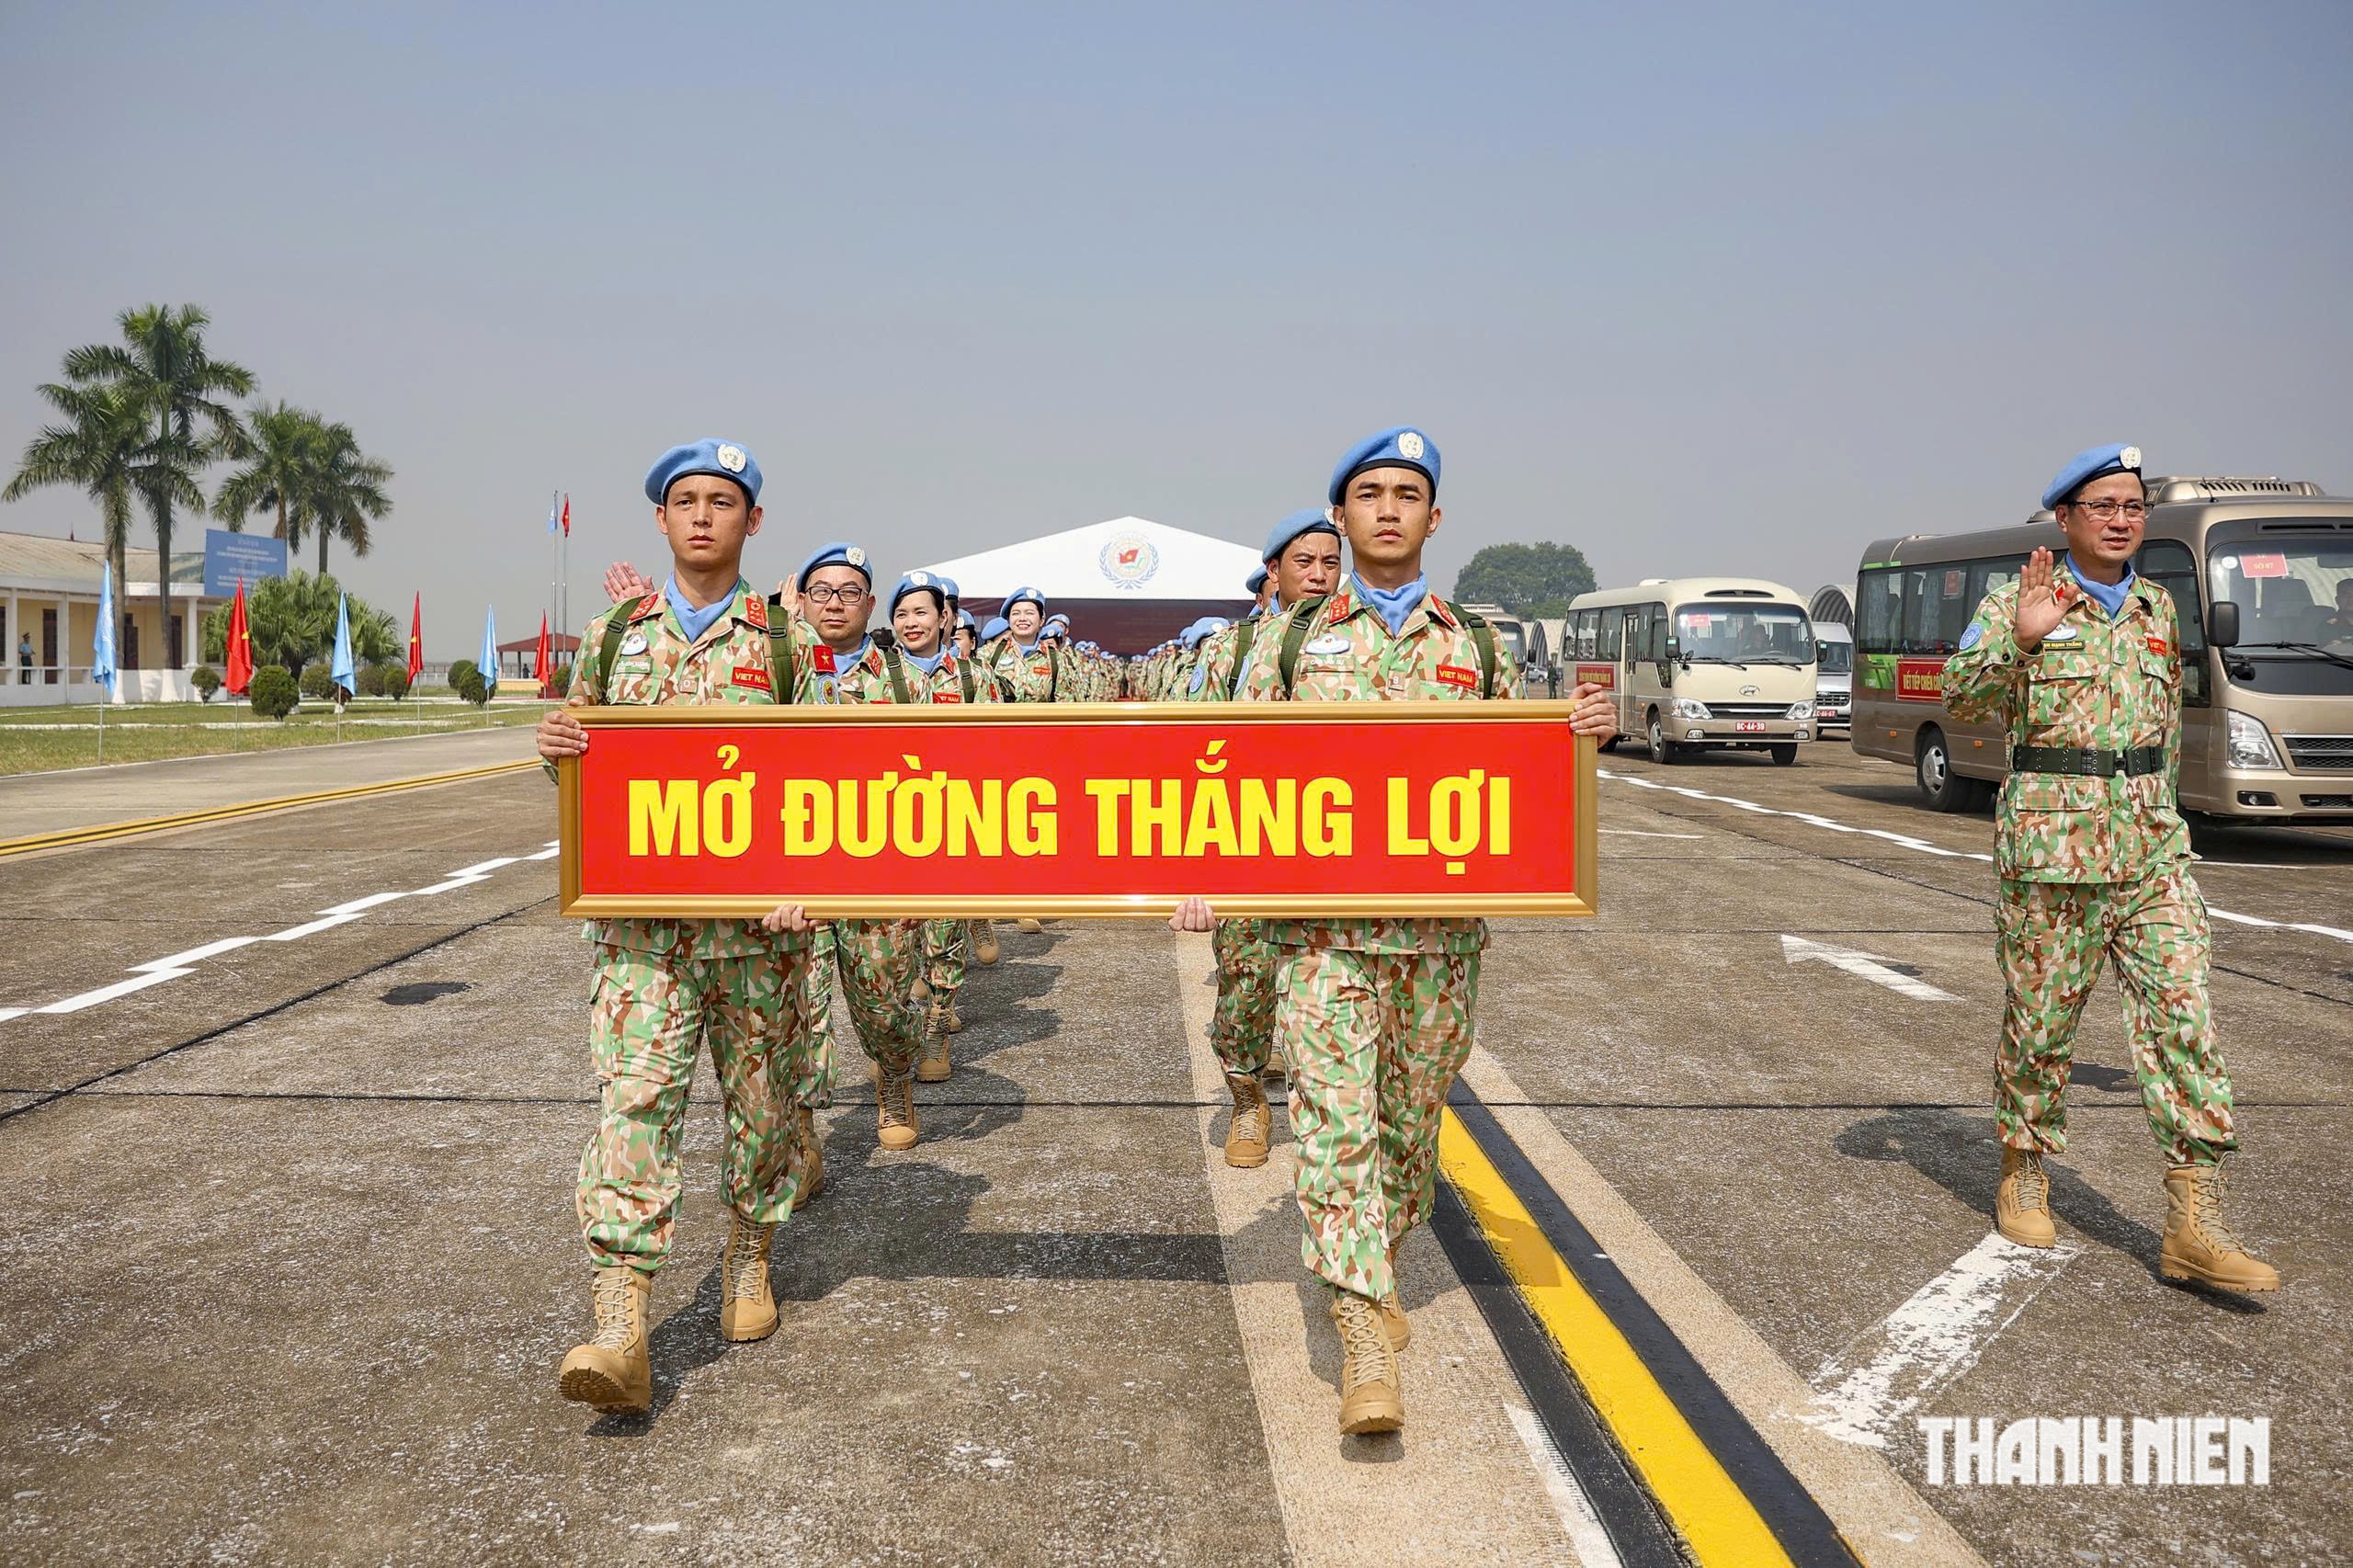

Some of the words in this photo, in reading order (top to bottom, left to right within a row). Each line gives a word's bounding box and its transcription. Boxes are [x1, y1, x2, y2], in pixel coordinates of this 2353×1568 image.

[735, 672, 753, 681] VIET
[1439, 670, 1456, 679] VIET
[1457, 673, 1472, 682] NAM
[629, 744, 756, 858] MỞ
[780, 754, 1059, 858] ĐƯỜNG
[1085, 739, 1353, 858] THẮNG
[1386, 768, 1510, 875] LỢI
